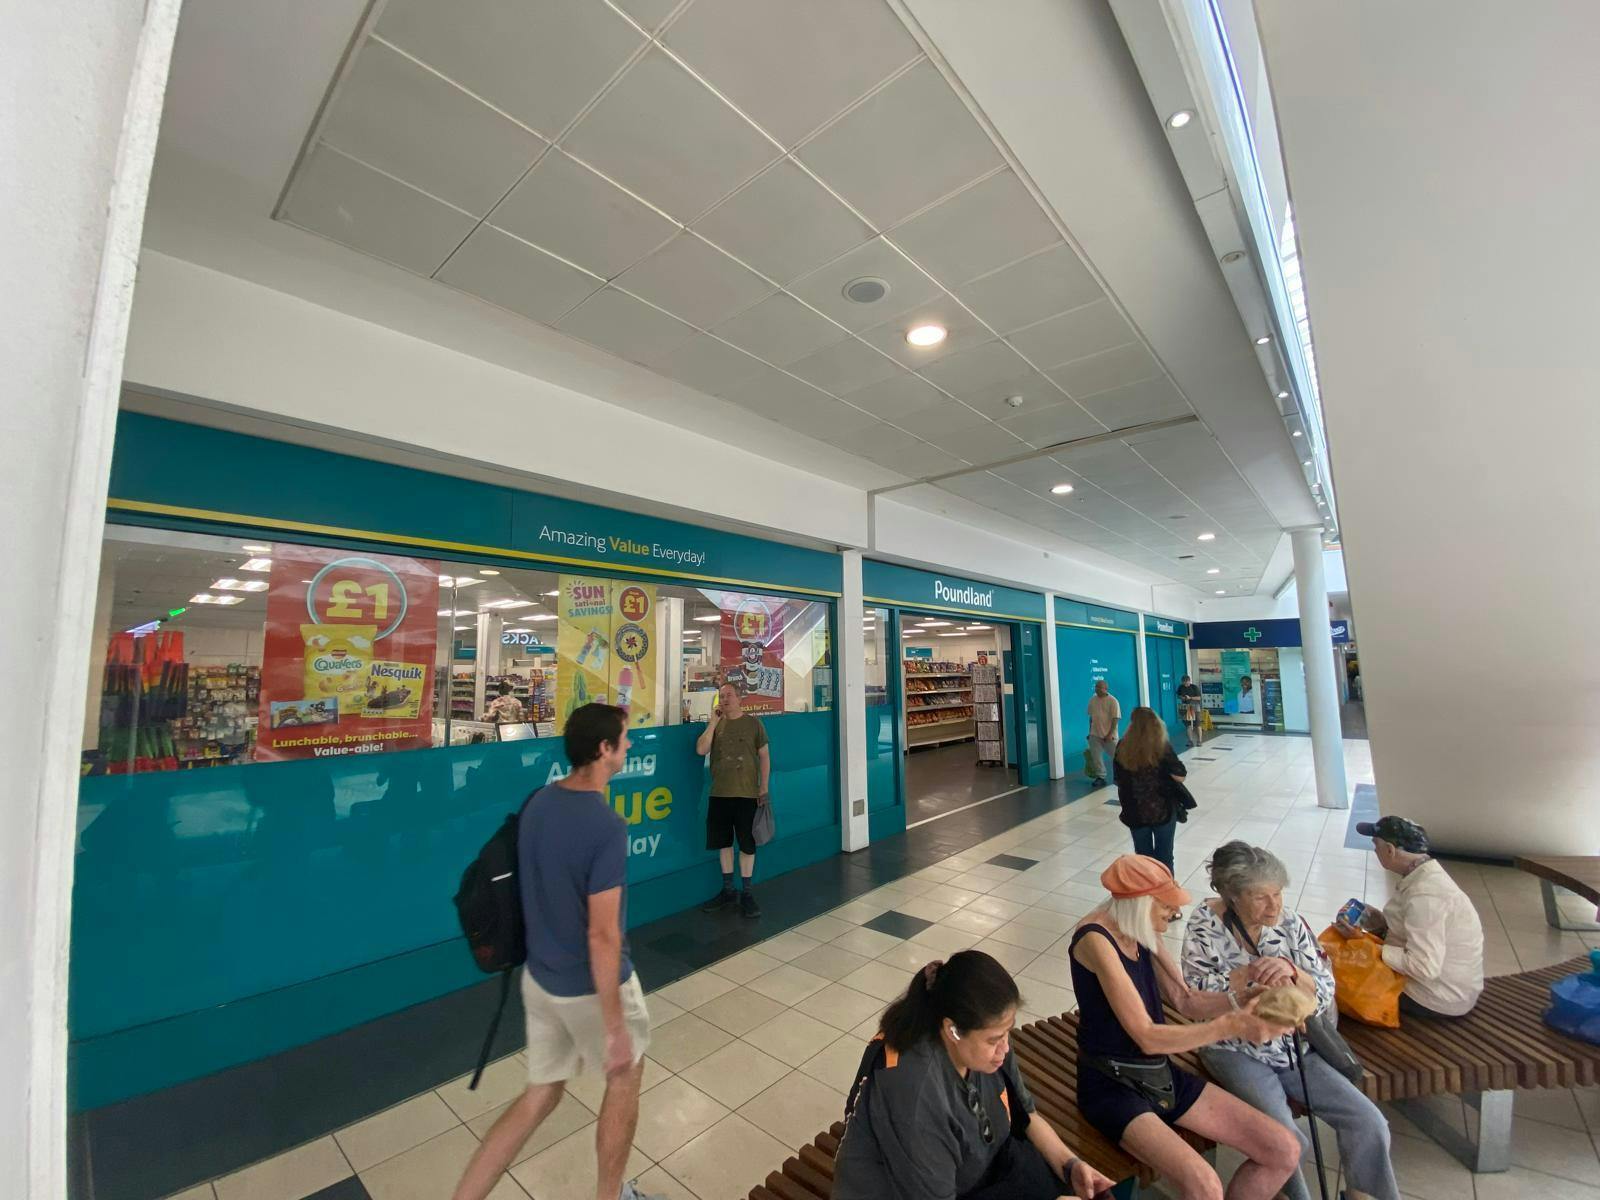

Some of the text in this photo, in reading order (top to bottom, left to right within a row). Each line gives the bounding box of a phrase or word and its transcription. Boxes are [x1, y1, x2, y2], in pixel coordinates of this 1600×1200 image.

[539, 525, 706, 567] Amazing Value Everyday!
[326, 580, 388, 619] £1
[572, 585, 605, 600] SUN
[934, 580, 993, 608] Poundland
[623, 595, 645, 614] £1
[314, 657, 363, 672] Quavers
[371, 663, 423, 681] Nesquik
[272, 730, 418, 748] Lunchable, brunchable...
[314, 743, 384, 757] Value-able!
